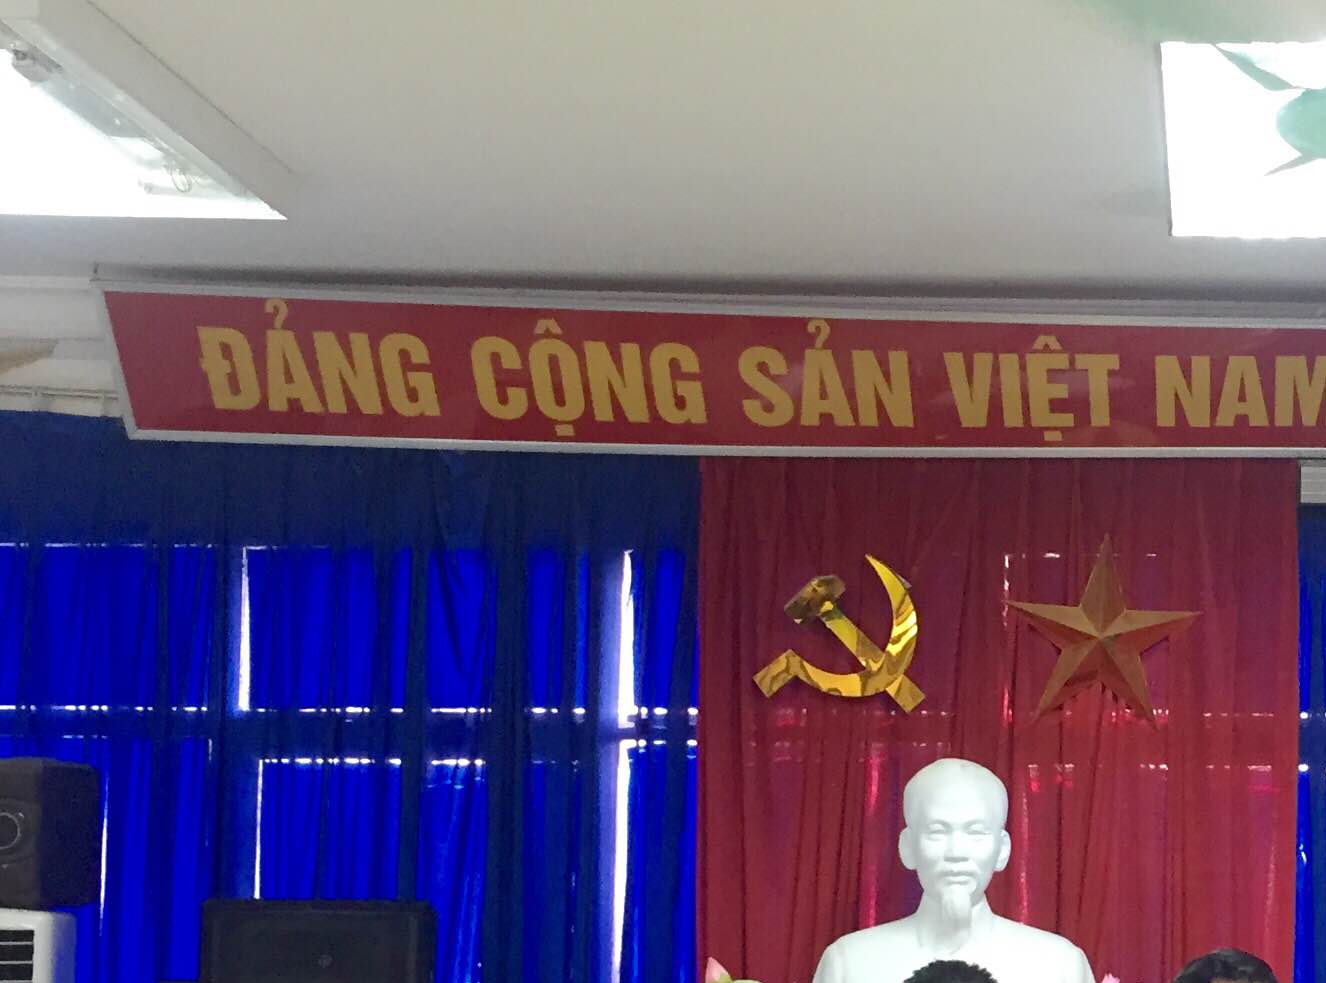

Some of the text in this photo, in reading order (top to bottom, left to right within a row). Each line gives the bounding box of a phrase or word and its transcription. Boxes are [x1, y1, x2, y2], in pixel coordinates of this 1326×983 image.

[198, 298, 440, 417] ĐẢNG
[471, 319, 707, 437] CỘNG
[738, 318, 914, 427] SẢN
[944, 335, 1120, 441] VIỆT
